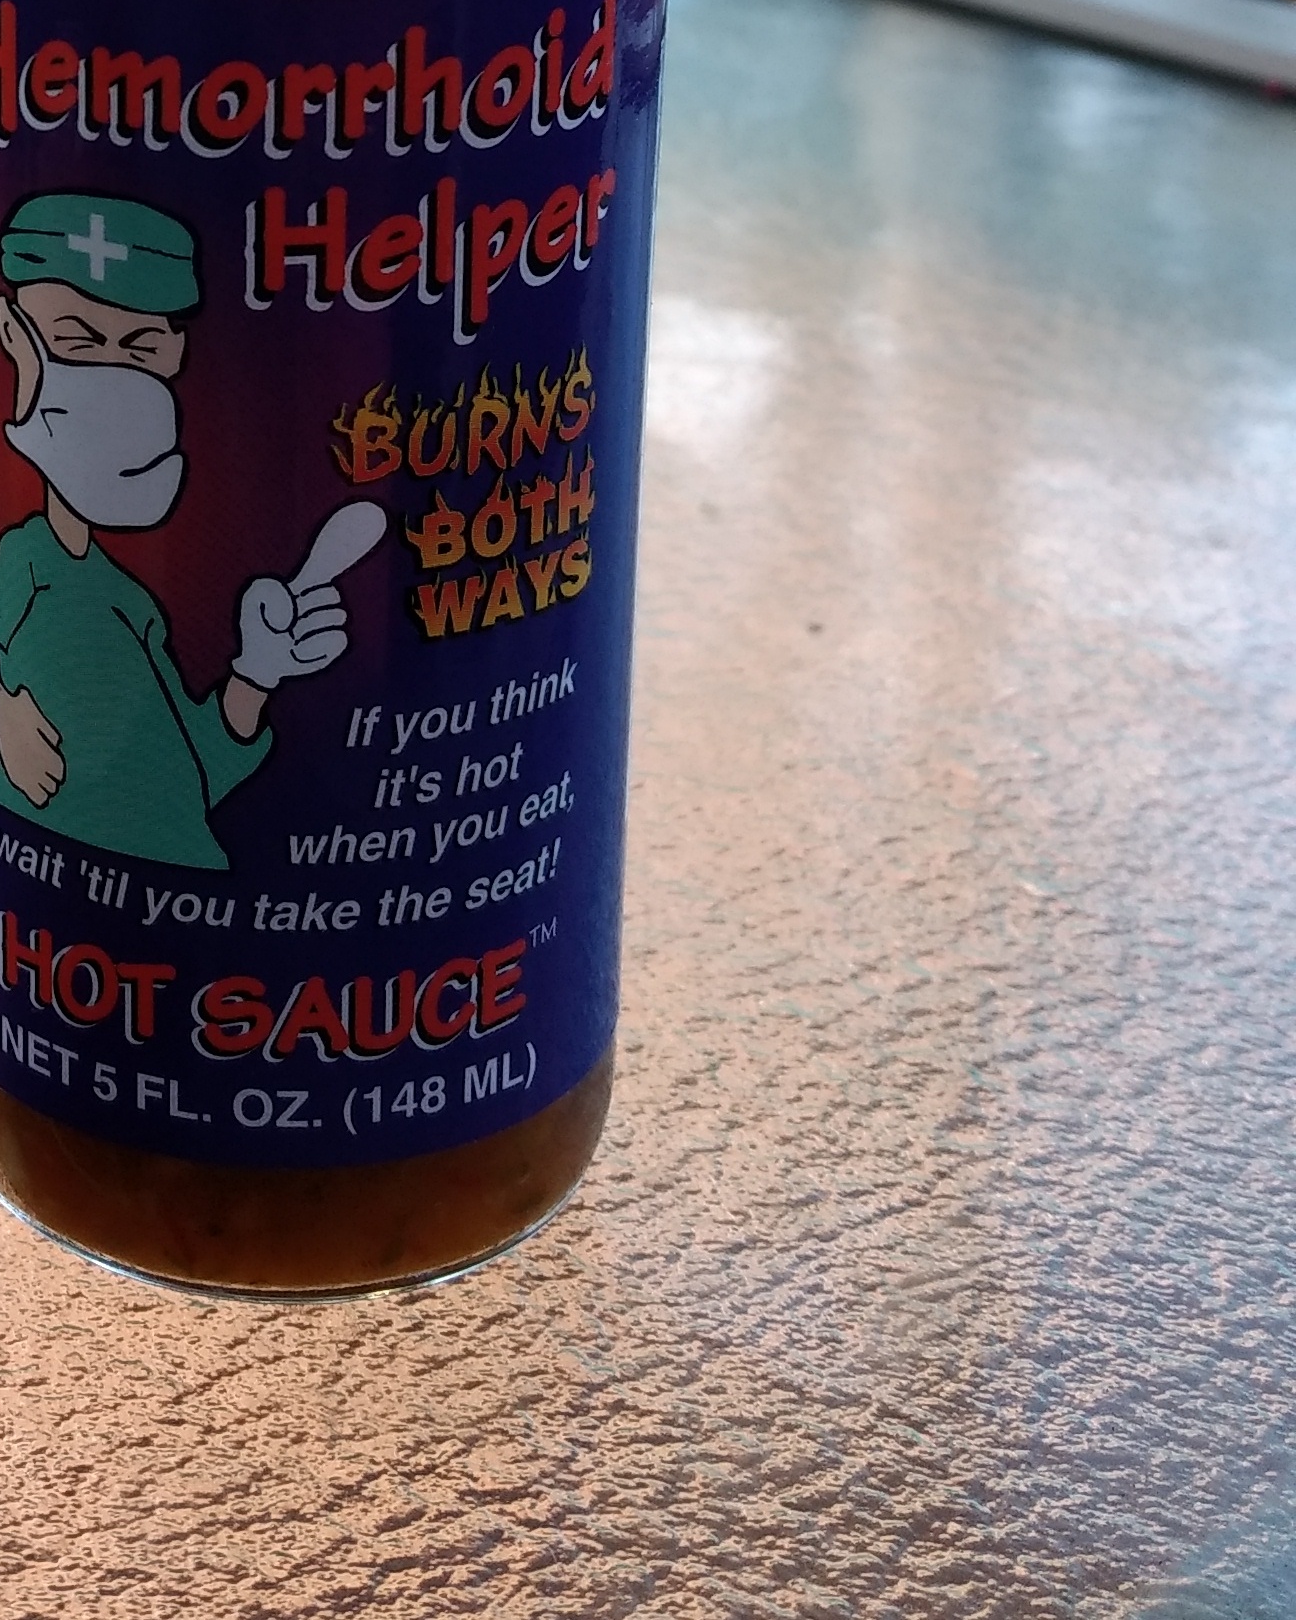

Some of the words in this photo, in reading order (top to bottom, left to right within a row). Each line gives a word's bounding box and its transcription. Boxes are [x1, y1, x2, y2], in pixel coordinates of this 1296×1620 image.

[244, 168, 616, 347] Helper
[334, 345, 596, 483] BURNS
[407, 448, 596, 568] BOTH
[413, 535, 594, 639] WAYS
[346, 705, 383, 748] If
[390, 701, 477, 754] you
[489, 656, 580, 727] think
[288, 824, 415, 866] when
[428, 802, 509, 863] you
[518, 776, 576, 829] eat,
[373, 762, 442, 809] it's
[455, 741, 524, 797] hot
[79, 861, 127, 910] 'til
[141, 885, 234, 928] you
[252, 891, 361, 933] take
[376, 883, 450, 927] the
[464, 836, 562, 913] seat!
[191, 936, 528, 1064] SAUCE
[0, 1014, 79, 1086] NET
[92, 1062, 118, 1103] 5
[135, 1073, 213, 1124] FL.
[232, 1087, 323, 1131] OZ.
[341, 1076, 447, 1136] (148
[462, 1040, 539, 1104] ML)
